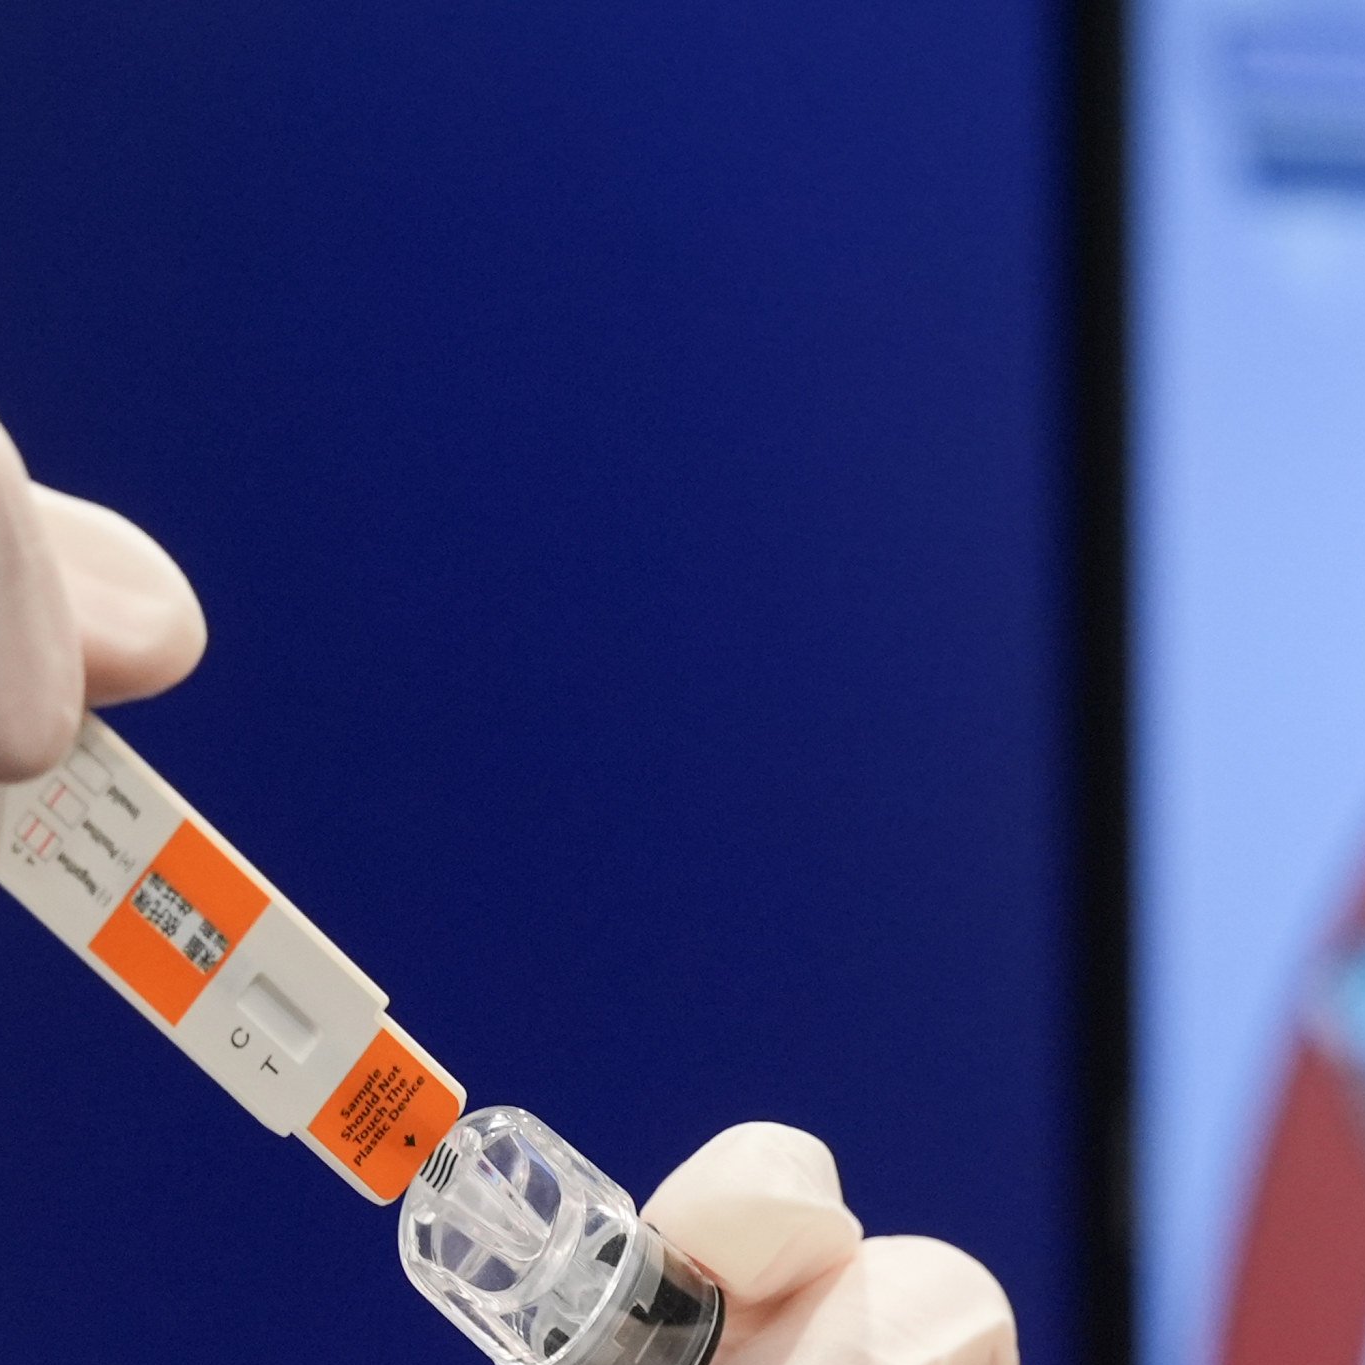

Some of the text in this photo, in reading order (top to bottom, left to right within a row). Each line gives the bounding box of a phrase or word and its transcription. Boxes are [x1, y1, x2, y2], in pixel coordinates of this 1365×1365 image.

[231, 1027, 250, 1049] C
[260, 1054, 280, 1076] T
[340, 1068, 382, 1119] Sample
[341, 1065, 401, 1141] Should Not
[353, 1079, 407, 1144] Touch The
[353, 1076, 425, 1167] Plastic Device
